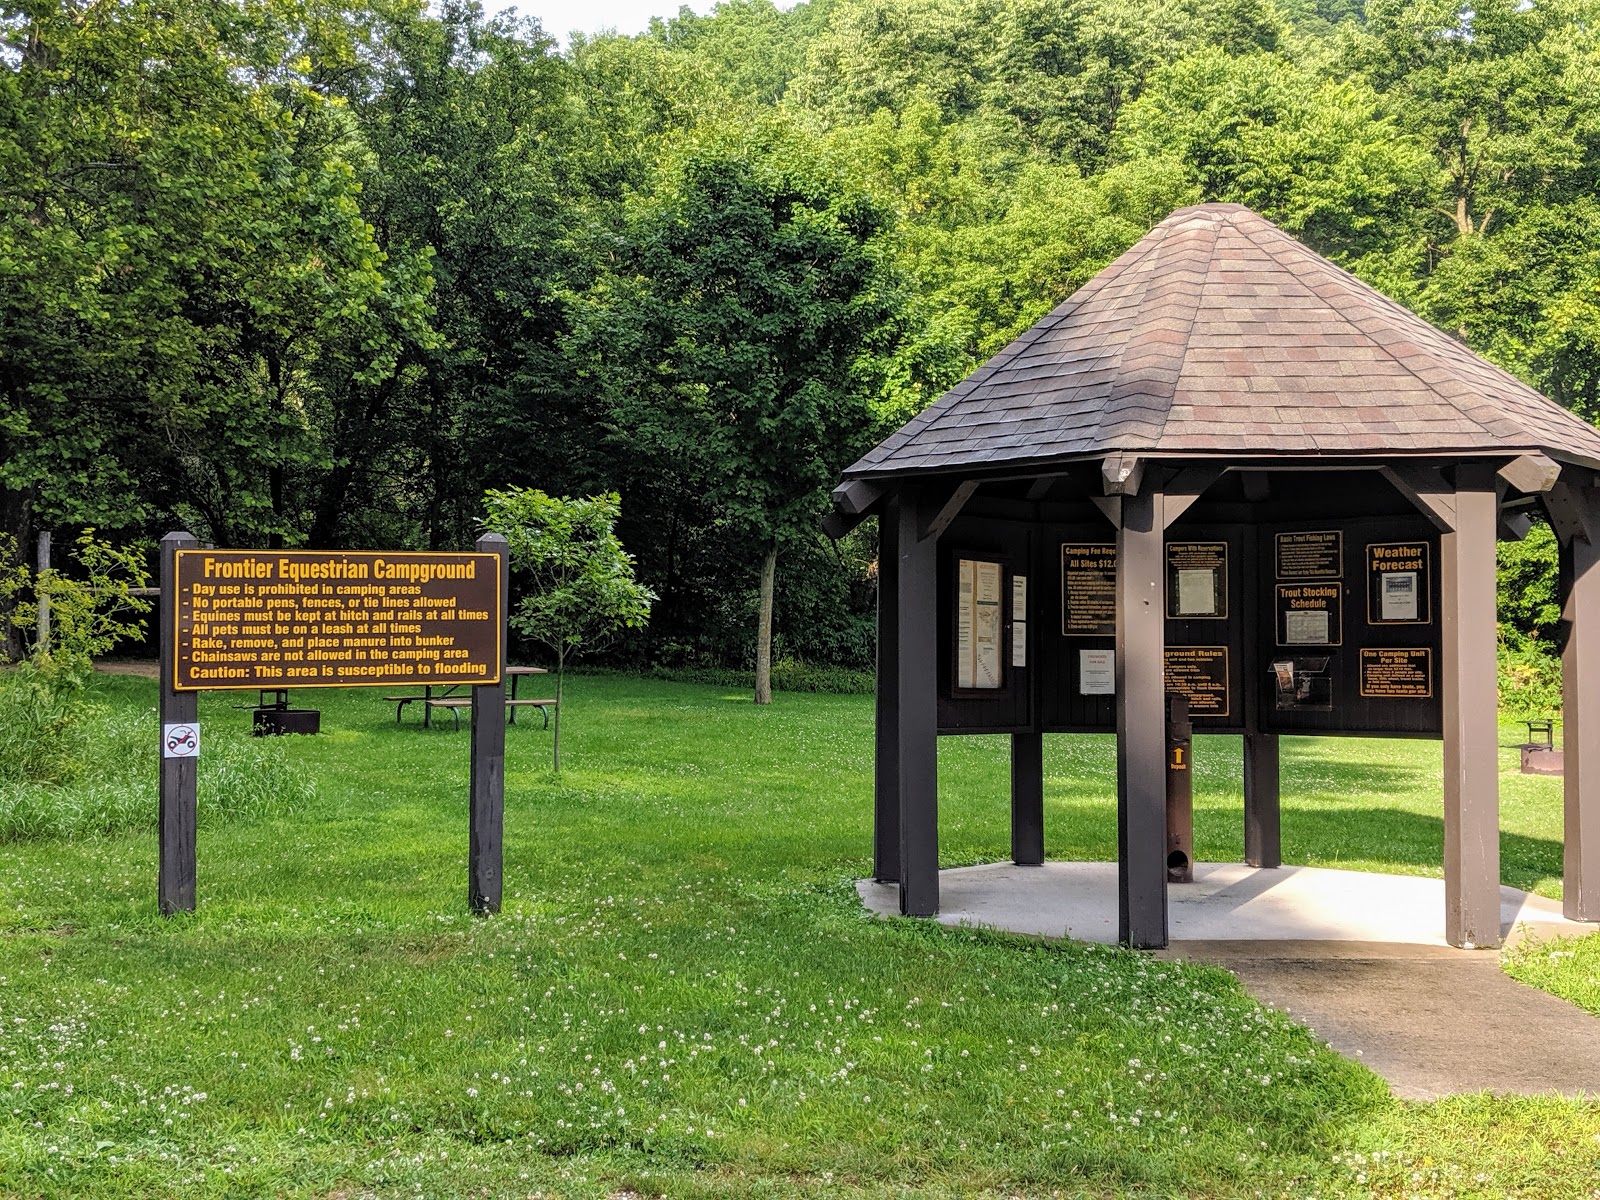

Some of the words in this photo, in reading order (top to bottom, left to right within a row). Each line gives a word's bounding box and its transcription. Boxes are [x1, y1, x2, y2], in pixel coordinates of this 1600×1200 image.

[1066, 547, 1090, 556] Camping
[1374, 547, 1422, 558] Weather
[204, 558, 274, 579] Frontier
[278, 558, 369, 582] Equestrian
[374, 559, 476, 583] Campground
[1070, 560, 1079, 568] All
[1080, 560, 1097, 568] Sites
[1372, 560, 1423, 570] Forecast
[192, 583, 216, 596] Day
[219, 586, 240, 594] use
[244, 584, 255, 594] is
[258, 584, 318, 596] prohibited
[322, 584, 333, 594] in
[336, 584, 385, 596] camping
[389, 586, 421, 595] areas
[1280, 589, 1301, 598] Trout
[1304, 587, 1338, 598] Stocking
[192, 597, 209, 608] No
[212, 597, 263, 610] portable
[266, 599, 299, 610] pens,
[302, 597, 345, 609] fences,
[349, 599, 361, 607] or
[364, 597, 379, 607] tie
[382, 597, 409, 607] lines
[413, 597, 457, 607] allowed
[1290, 600, 1326, 608] Schedule
[192, 611, 240, 623] Equines
[244, 611, 273, 621] must
[277, 610, 291, 621] be
[295, 610, 321, 623] kept
[324, 611, 337, 620] at
[340, 610, 369, 620] hitch
[373, 610, 394, 620] and
[397, 610, 423, 620] rails
[426, 611, 438, 620] at
[441, 610, 455, 620] all
[458, 610, 489, 620] times
[192, 624, 209, 635] All
[212, 625, 238, 636] pets
[242, 625, 271, 634] must
[275, 624, 289, 634] be
[293, 626, 307, 634] on
[311, 626, 318, 634] a
[322, 623, 353, 634] leash
[357, 624, 368, 634] at
[372, 623, 387, 633] all
[390, 623, 422, 633] times
[192, 638, 227, 649] Rake,
[230, 639, 278, 649] remove,
[281, 637, 303, 648] and
[307, 637, 339, 649] place
[343, 637, 386, 646] manure
[390, 636, 412, 646] into
[415, 635, 454, 646] bunker
[192, 651, 257, 662] Chainsaws
[261, 652, 280, 661] are
[284, 650, 303, 661] not
[307, 650, 352, 660] allowed
[356, 649, 366, 659] in
[370, 649, 388, 659] the
[392, 648, 440, 661] camping
[443, 650, 468, 658] area
[189, 666, 250, 679] Caution:
[254, 665, 283, 677] This
[286, 666, 317, 676] area
[322, 665, 334, 676] is
[337, 663, 413, 677] susceptible
[418, 663, 431, 674] to
[435, 662, 487, 675] flooding
